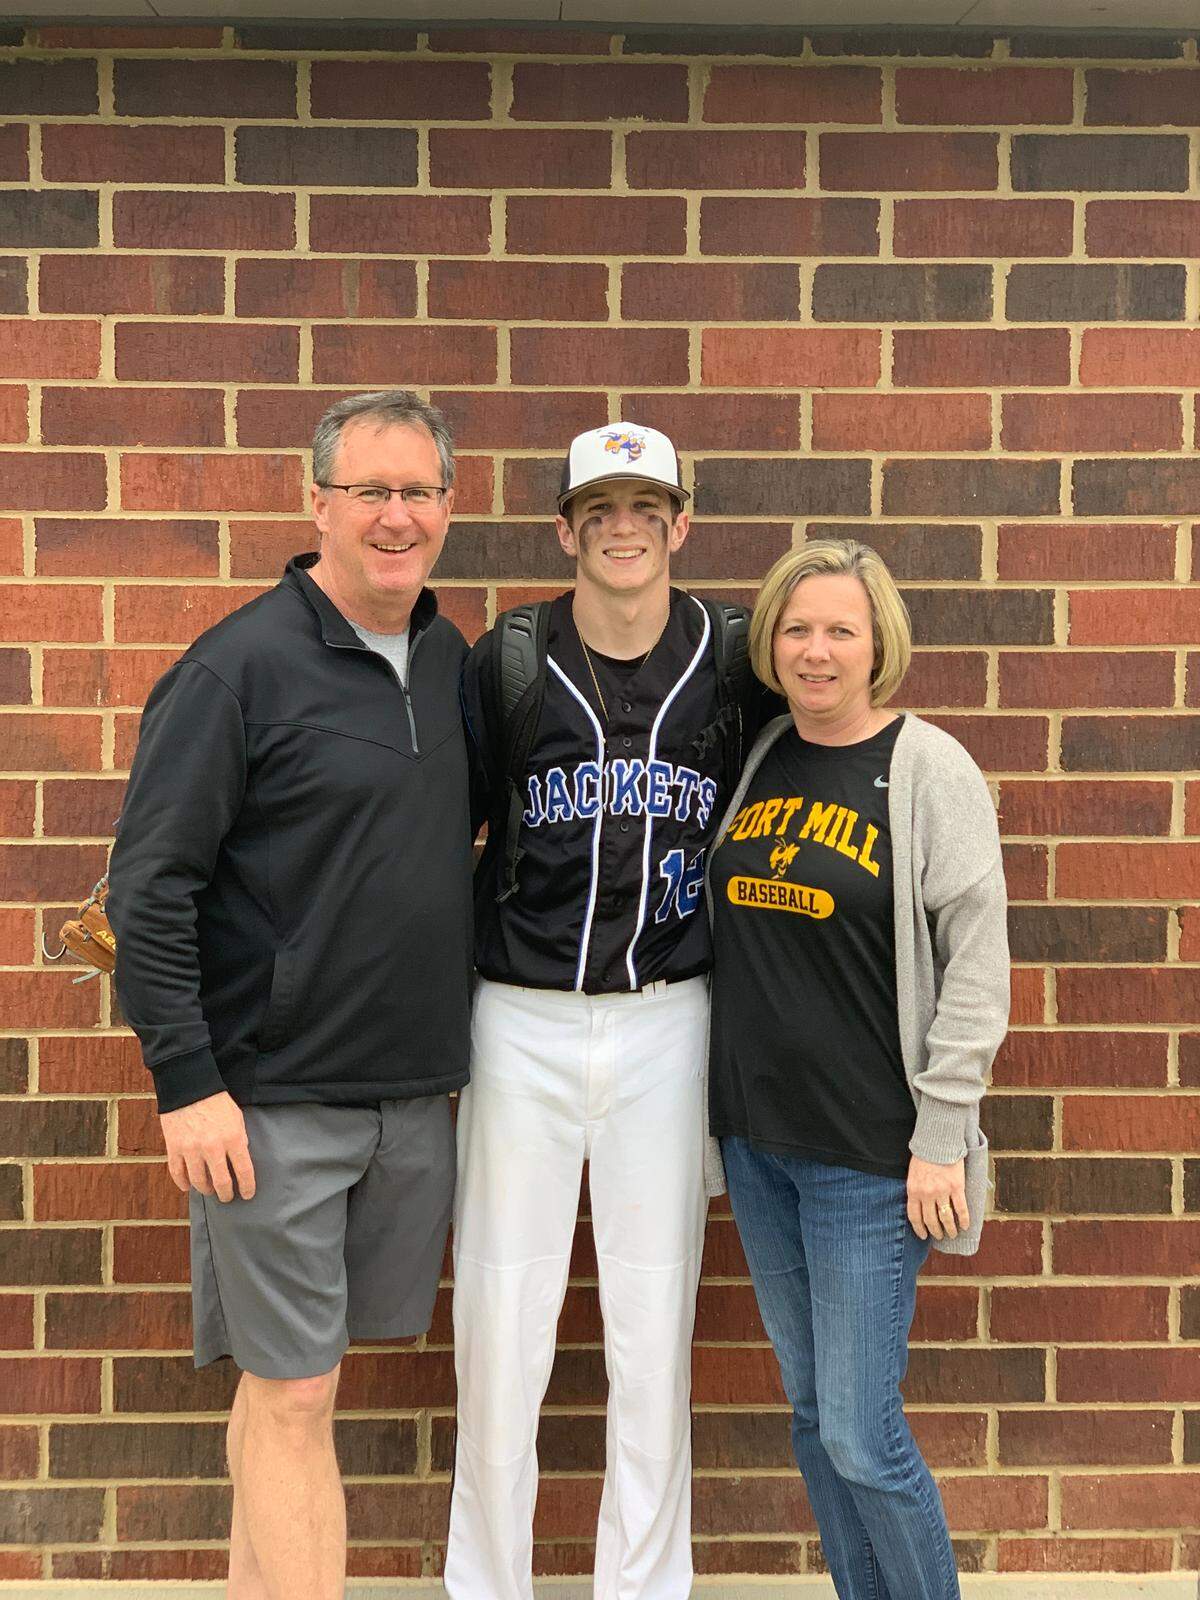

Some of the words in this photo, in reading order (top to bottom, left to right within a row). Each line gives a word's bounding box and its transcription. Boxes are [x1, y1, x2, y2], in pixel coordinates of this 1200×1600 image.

[523, 759, 717, 829] JACKETS
[799, 801, 880, 878] MILL
[737, 880, 820, 914] BASEBALL
